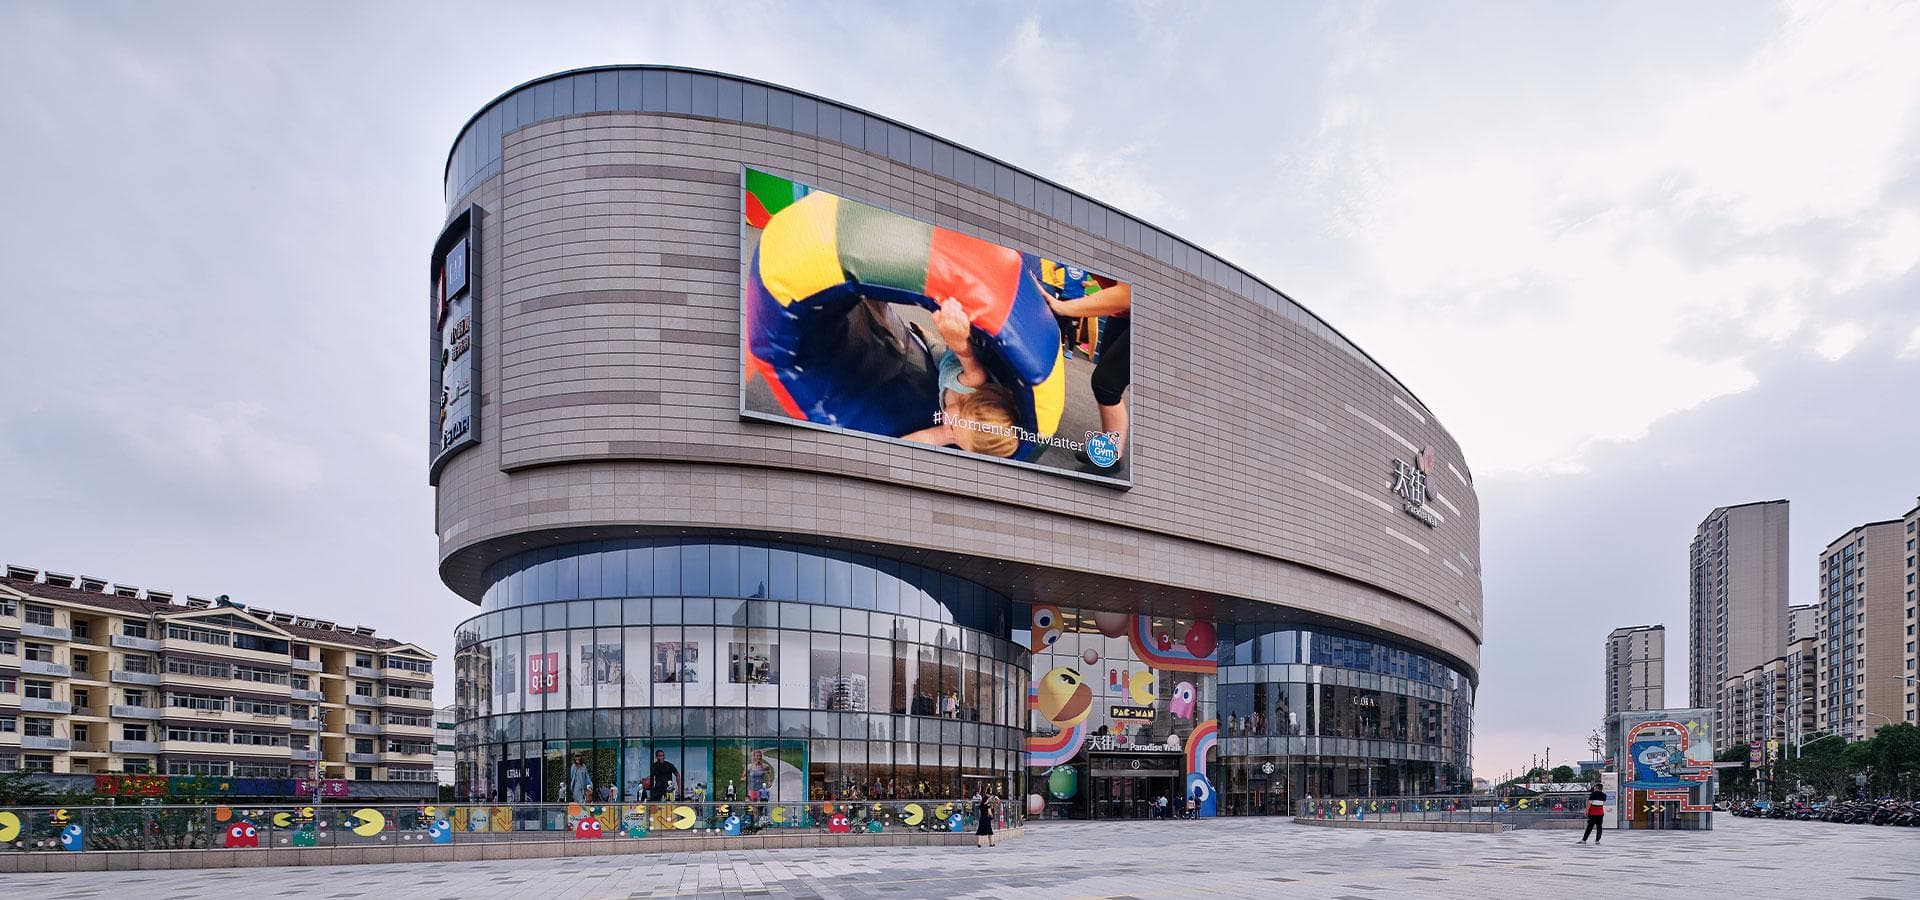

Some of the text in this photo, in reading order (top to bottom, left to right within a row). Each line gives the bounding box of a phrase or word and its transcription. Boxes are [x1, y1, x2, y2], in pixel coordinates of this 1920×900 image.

[932, 410, 1085, 453] #MomentsThatMatter
[1393, 457, 1427, 507] 天街
[1112, 707, 1154, 718] PAC-MAN
[1088, 735, 1115, 751] 天街
[1129, 743, 1183, 752] Paradise Walk
